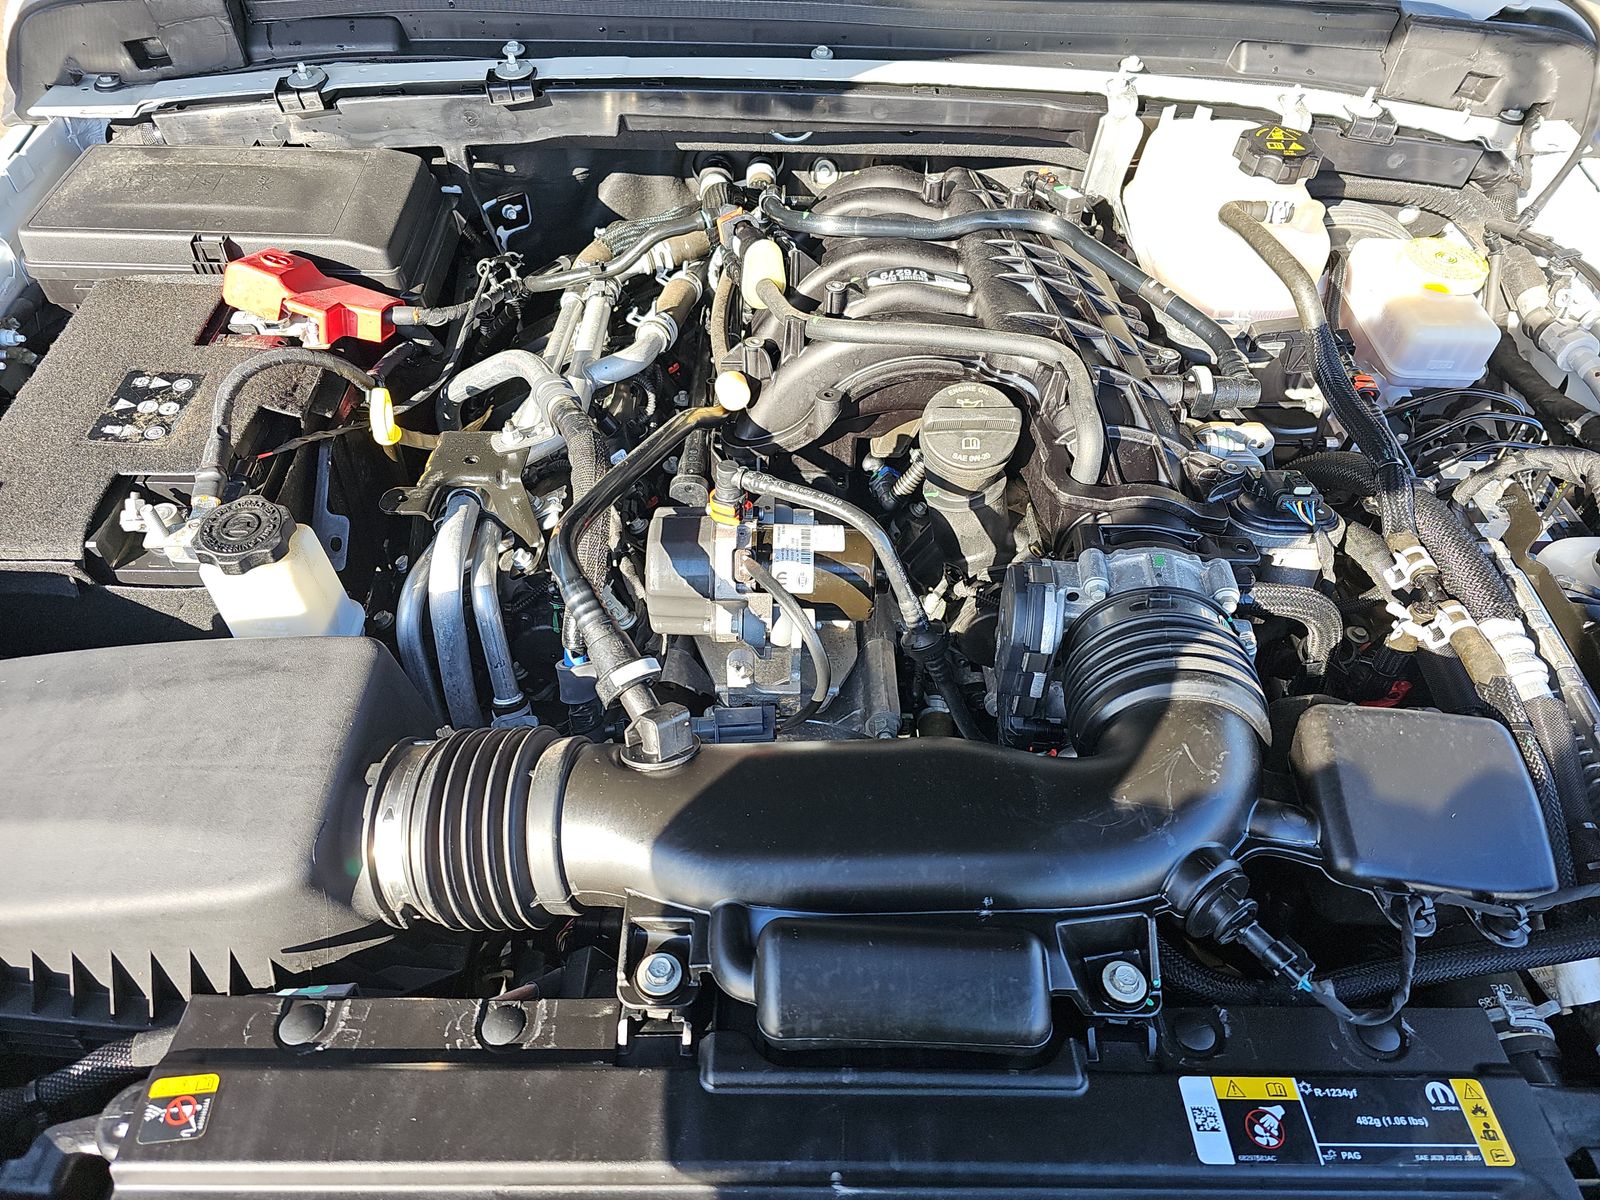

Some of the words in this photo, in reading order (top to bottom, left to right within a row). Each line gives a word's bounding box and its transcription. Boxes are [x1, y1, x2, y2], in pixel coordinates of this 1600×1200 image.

[948, 385, 977, 396] ENGINE
[978, 386, 991, 396] OIL
[952, 452, 968, 461] SAE
[969, 452, 991, 461] 0W-20
[1313, 1088, 1358, 1099] R-1234yf
[1356, 1116, 1382, 1127] 482g
[1382, 1116, 1407, 1127] (1.06
[1408, 1116, 1429, 1128] lbs)
[1341, 1151, 1362, 1160] PAG
